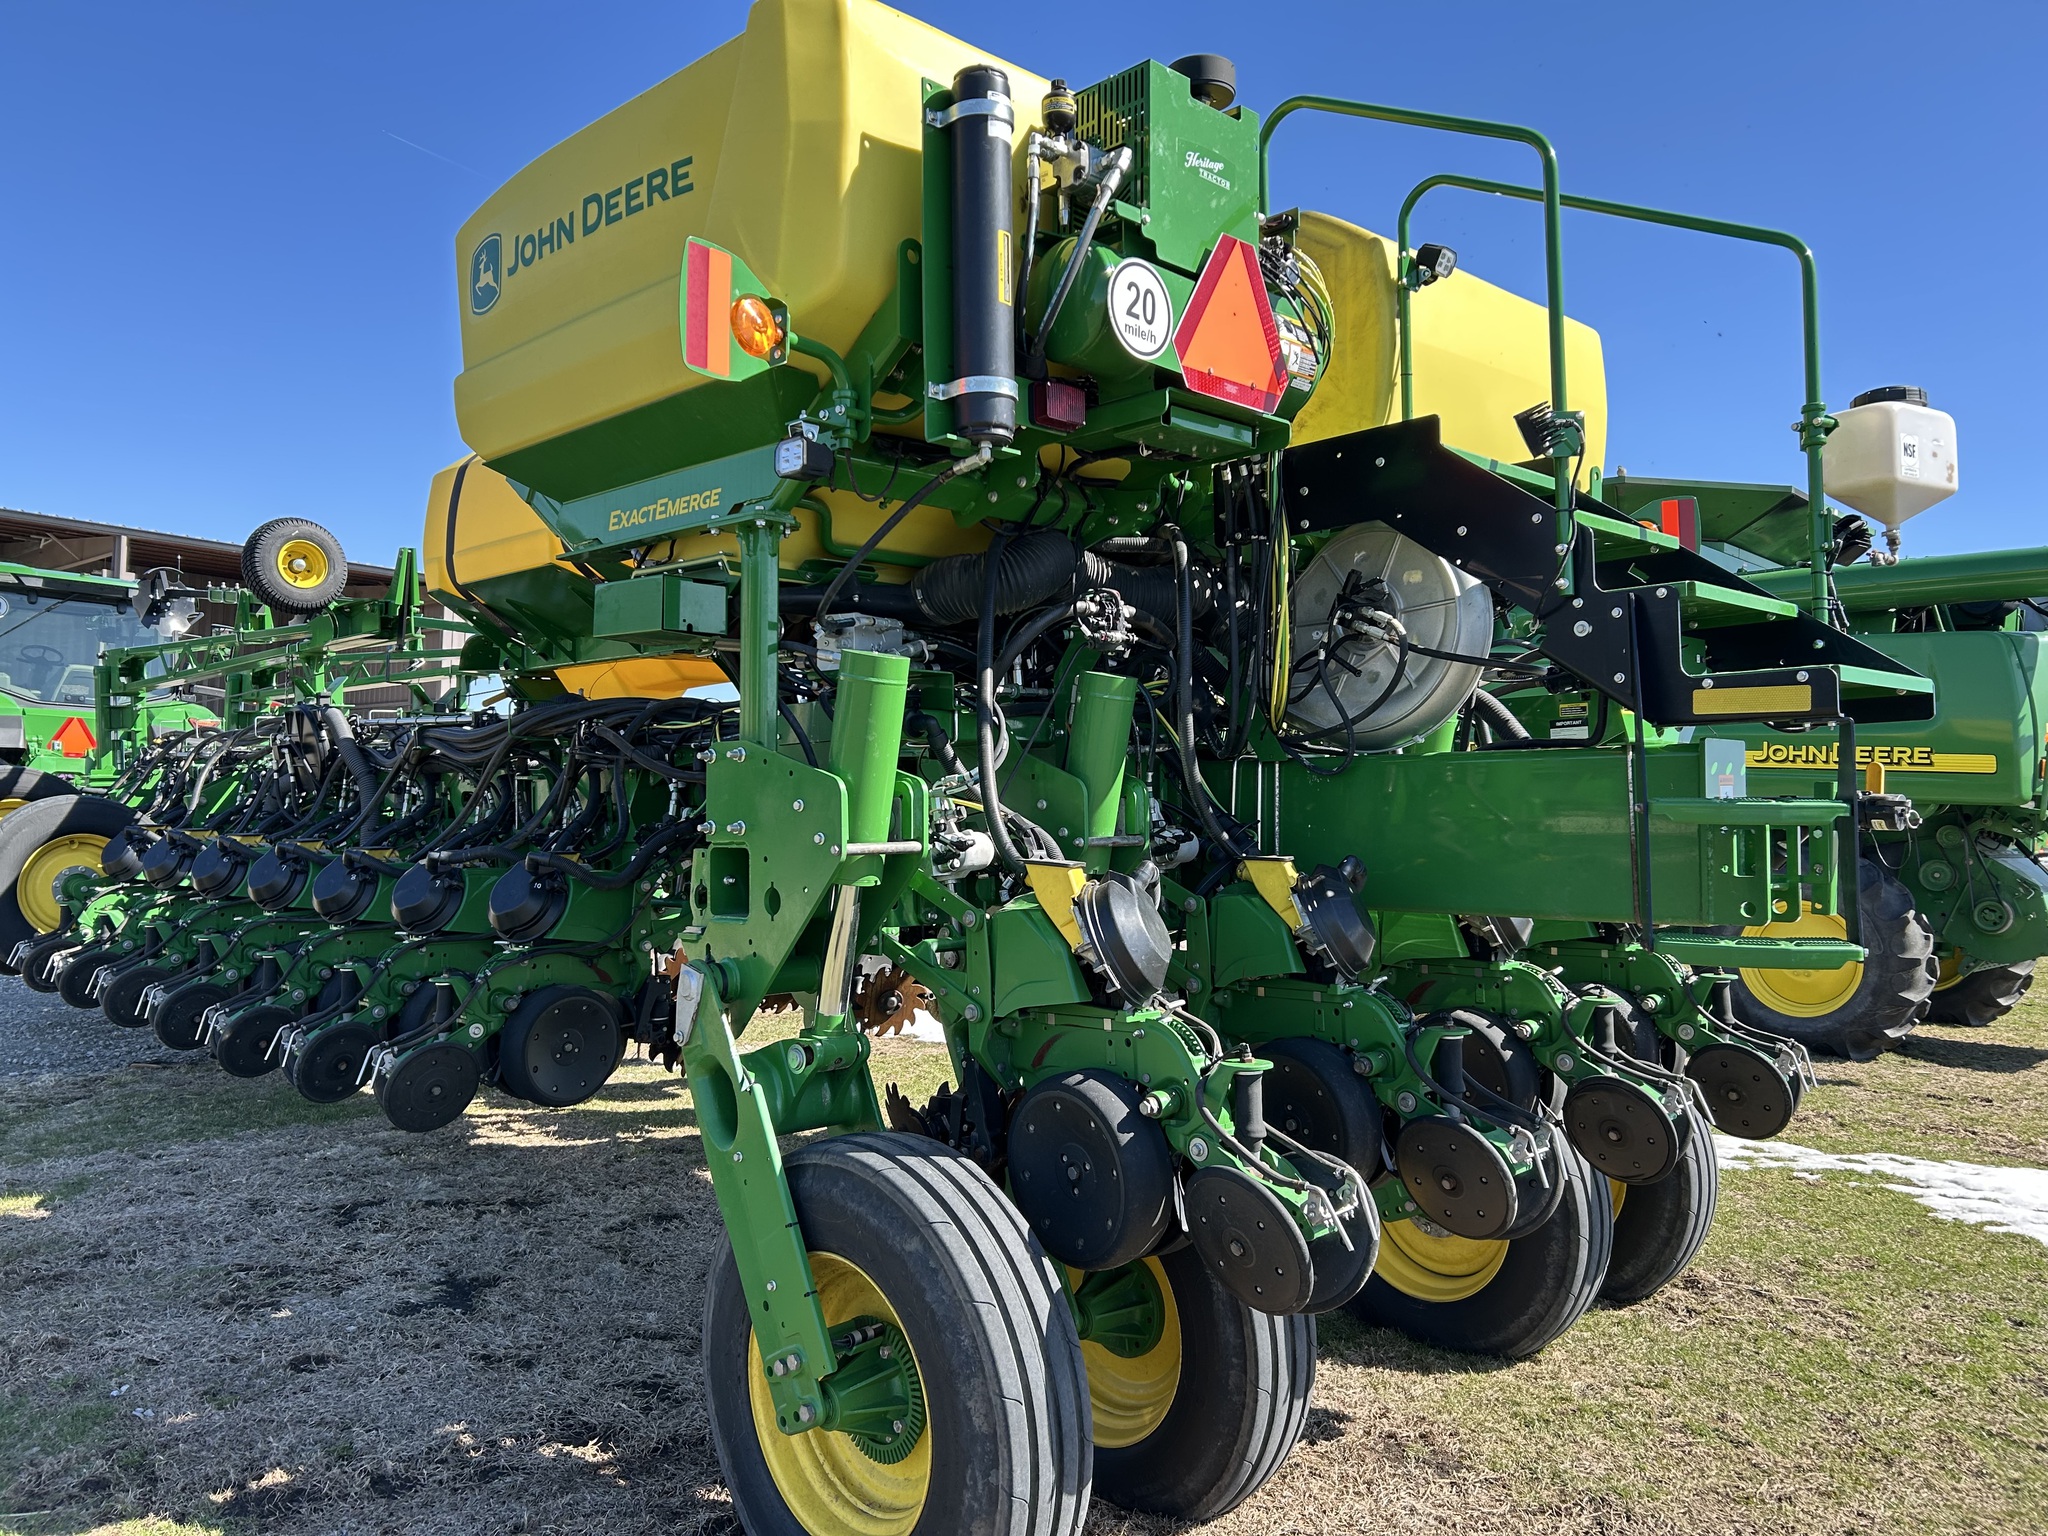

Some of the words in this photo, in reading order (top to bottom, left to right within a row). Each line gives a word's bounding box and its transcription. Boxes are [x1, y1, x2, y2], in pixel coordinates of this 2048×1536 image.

[1184, 151, 1224, 173] Heritage
[507, 210, 575, 277] JOHN
[582, 155, 694, 237] DEERE
[1126, 281, 1156, 326] 20
[1124, 323, 1157, 345] mile/h
[1903, 442, 1916, 458] NSF
[1753, 741, 1828, 764] JOHN
